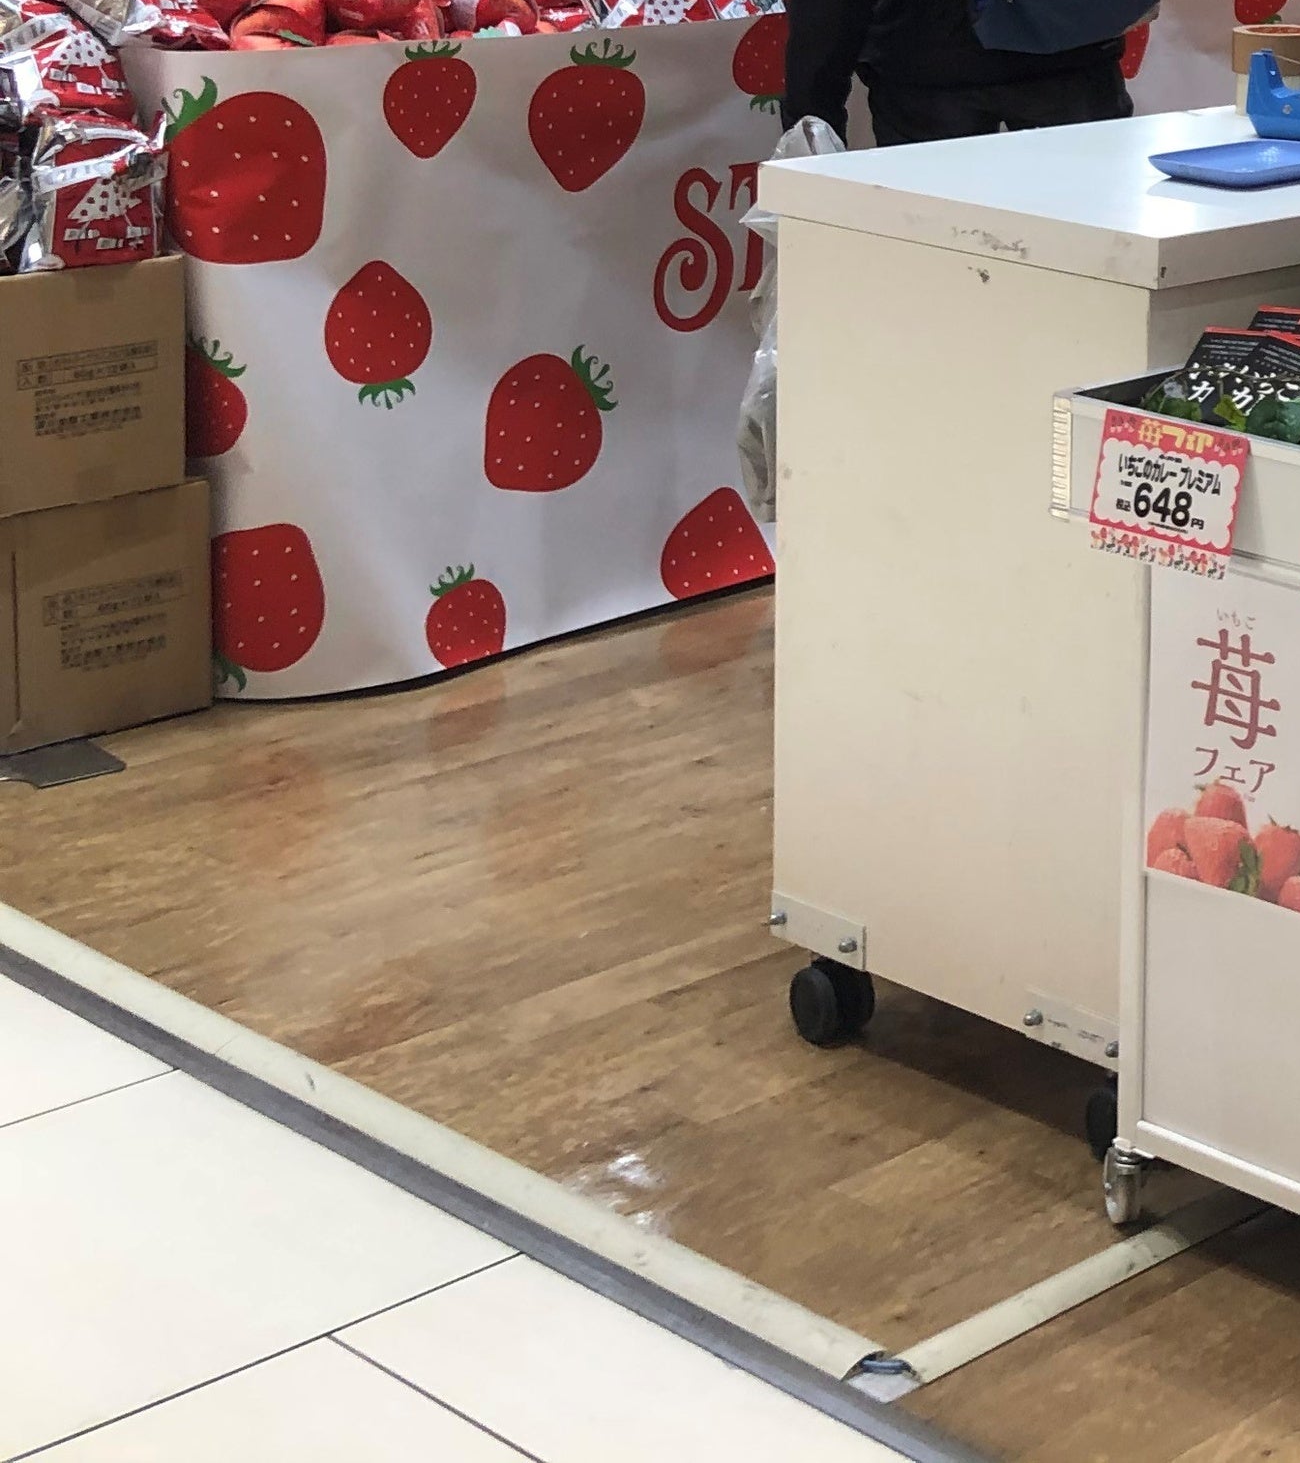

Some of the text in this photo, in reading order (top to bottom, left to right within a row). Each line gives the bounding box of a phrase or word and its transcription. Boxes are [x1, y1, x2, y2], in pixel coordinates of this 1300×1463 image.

[1118, 453, 1222, 497] いちごのカレー プレミアム
[1215, 606, 1257, 631] いちご
[1190, 628, 1282, 750] 苺
[1193, 746, 1276, 795] フェア
